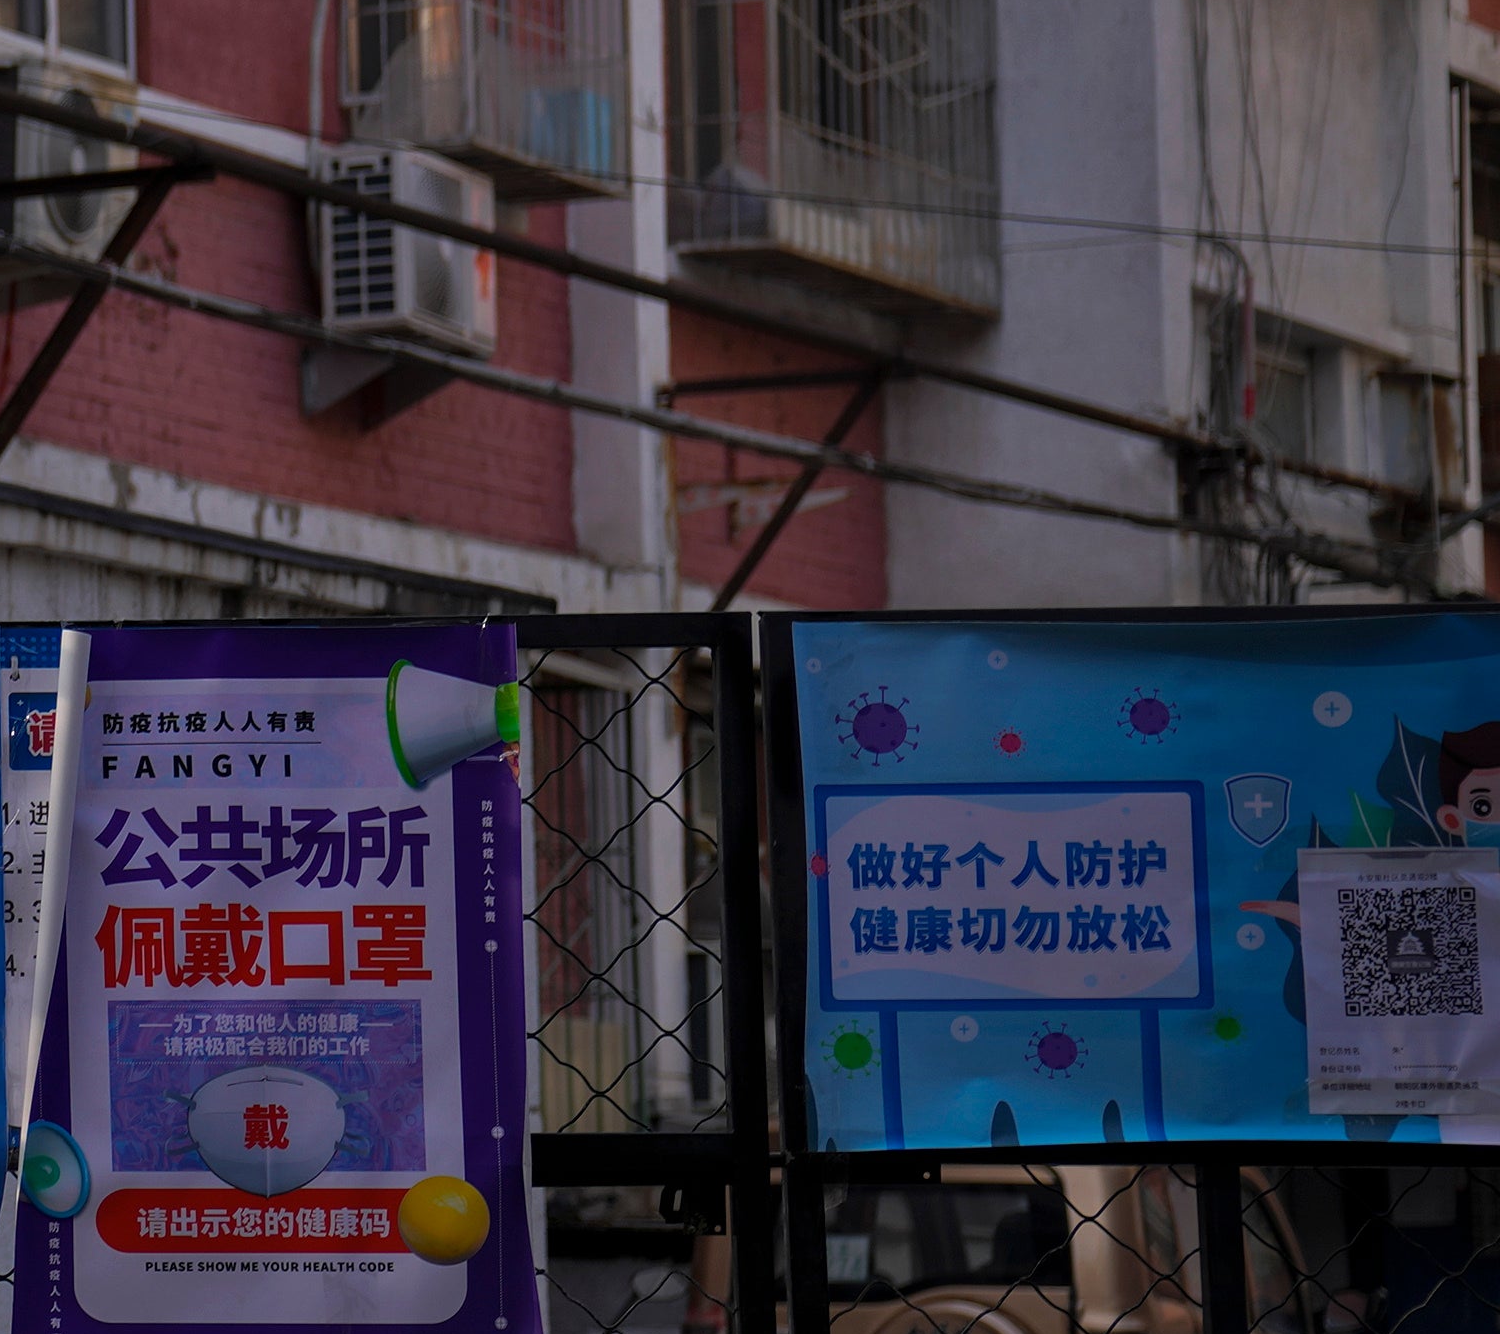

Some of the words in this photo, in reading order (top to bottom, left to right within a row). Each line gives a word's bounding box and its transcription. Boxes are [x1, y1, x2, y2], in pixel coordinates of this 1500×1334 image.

[102, 710, 317, 735] 防疫抗疫人人有责
[102, 753, 292, 779] FANGYI
[94, 804, 431, 890] 公共场所
[480, 799, 497, 925] 防疫抗疫人人有责
[846, 840, 1169, 891] 做好个人防护
[94, 902, 433, 989] 佩戴口罩
[849, 905, 1172, 955] 健康切勿放松
[172, 1012, 360, 1035] 为了您和他人的健康
[163, 1035, 371, 1057] 请积极配合我们的工作
[243, 1103, 290, 1150] 戴
[136, 1206, 391, 1239] 请出示您的健康码
[145, 1261, 194, 1273] PLEASE
[198, 1261, 238, 1273] SHOW
[240, 1261, 259, 1273] ME
[263, 1261, 299, 1273] YOUR
[303, 1261, 356, 1273] HEALTH
[359, 1261, 395, 1273] CODE
